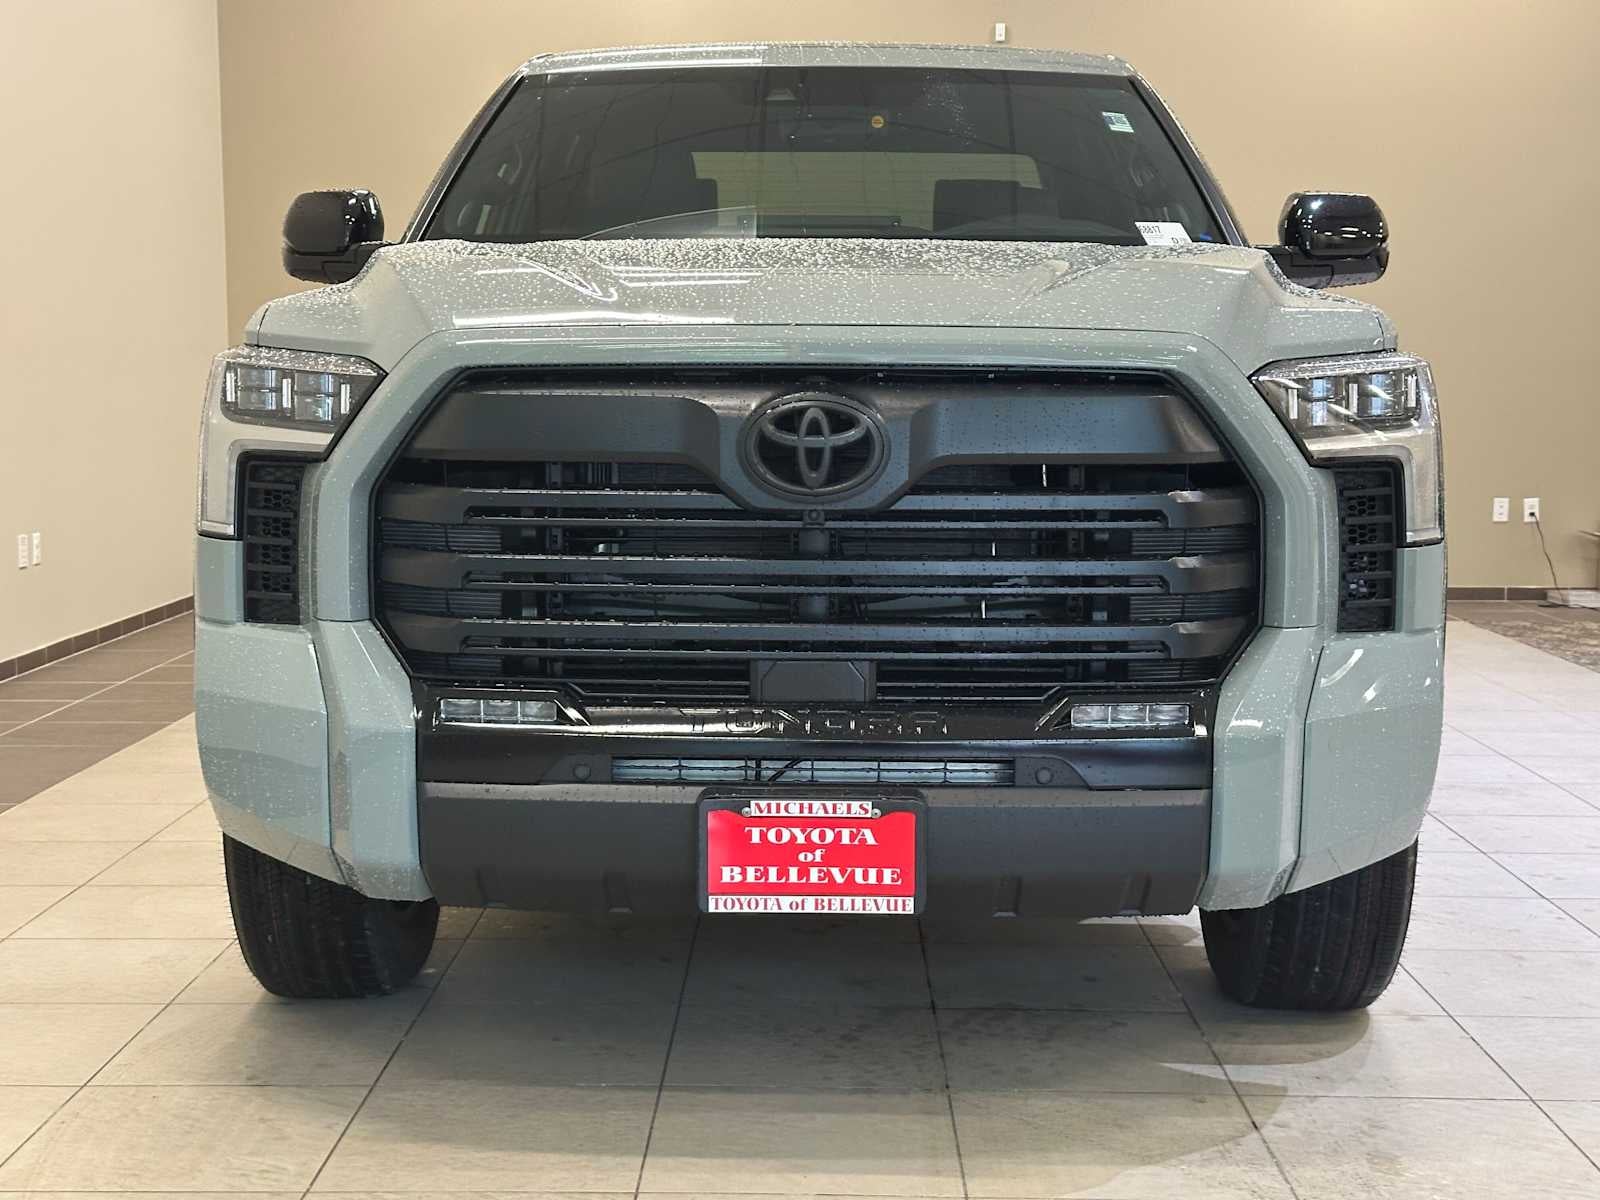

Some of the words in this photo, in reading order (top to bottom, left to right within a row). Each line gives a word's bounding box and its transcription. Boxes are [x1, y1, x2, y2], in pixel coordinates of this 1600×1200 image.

[679, 708, 949, 734] TUNDRA
[753, 802, 871, 815] MICHAELS
[745, 827, 878, 845] TOYOTA
[798, 849, 825, 862] of
[720, 866, 902, 885] BELLEVUE
[711, 897, 782, 911] TOYOTA
[789, 897, 808, 911] of
[814, 897, 912, 912] BELLEVUE
